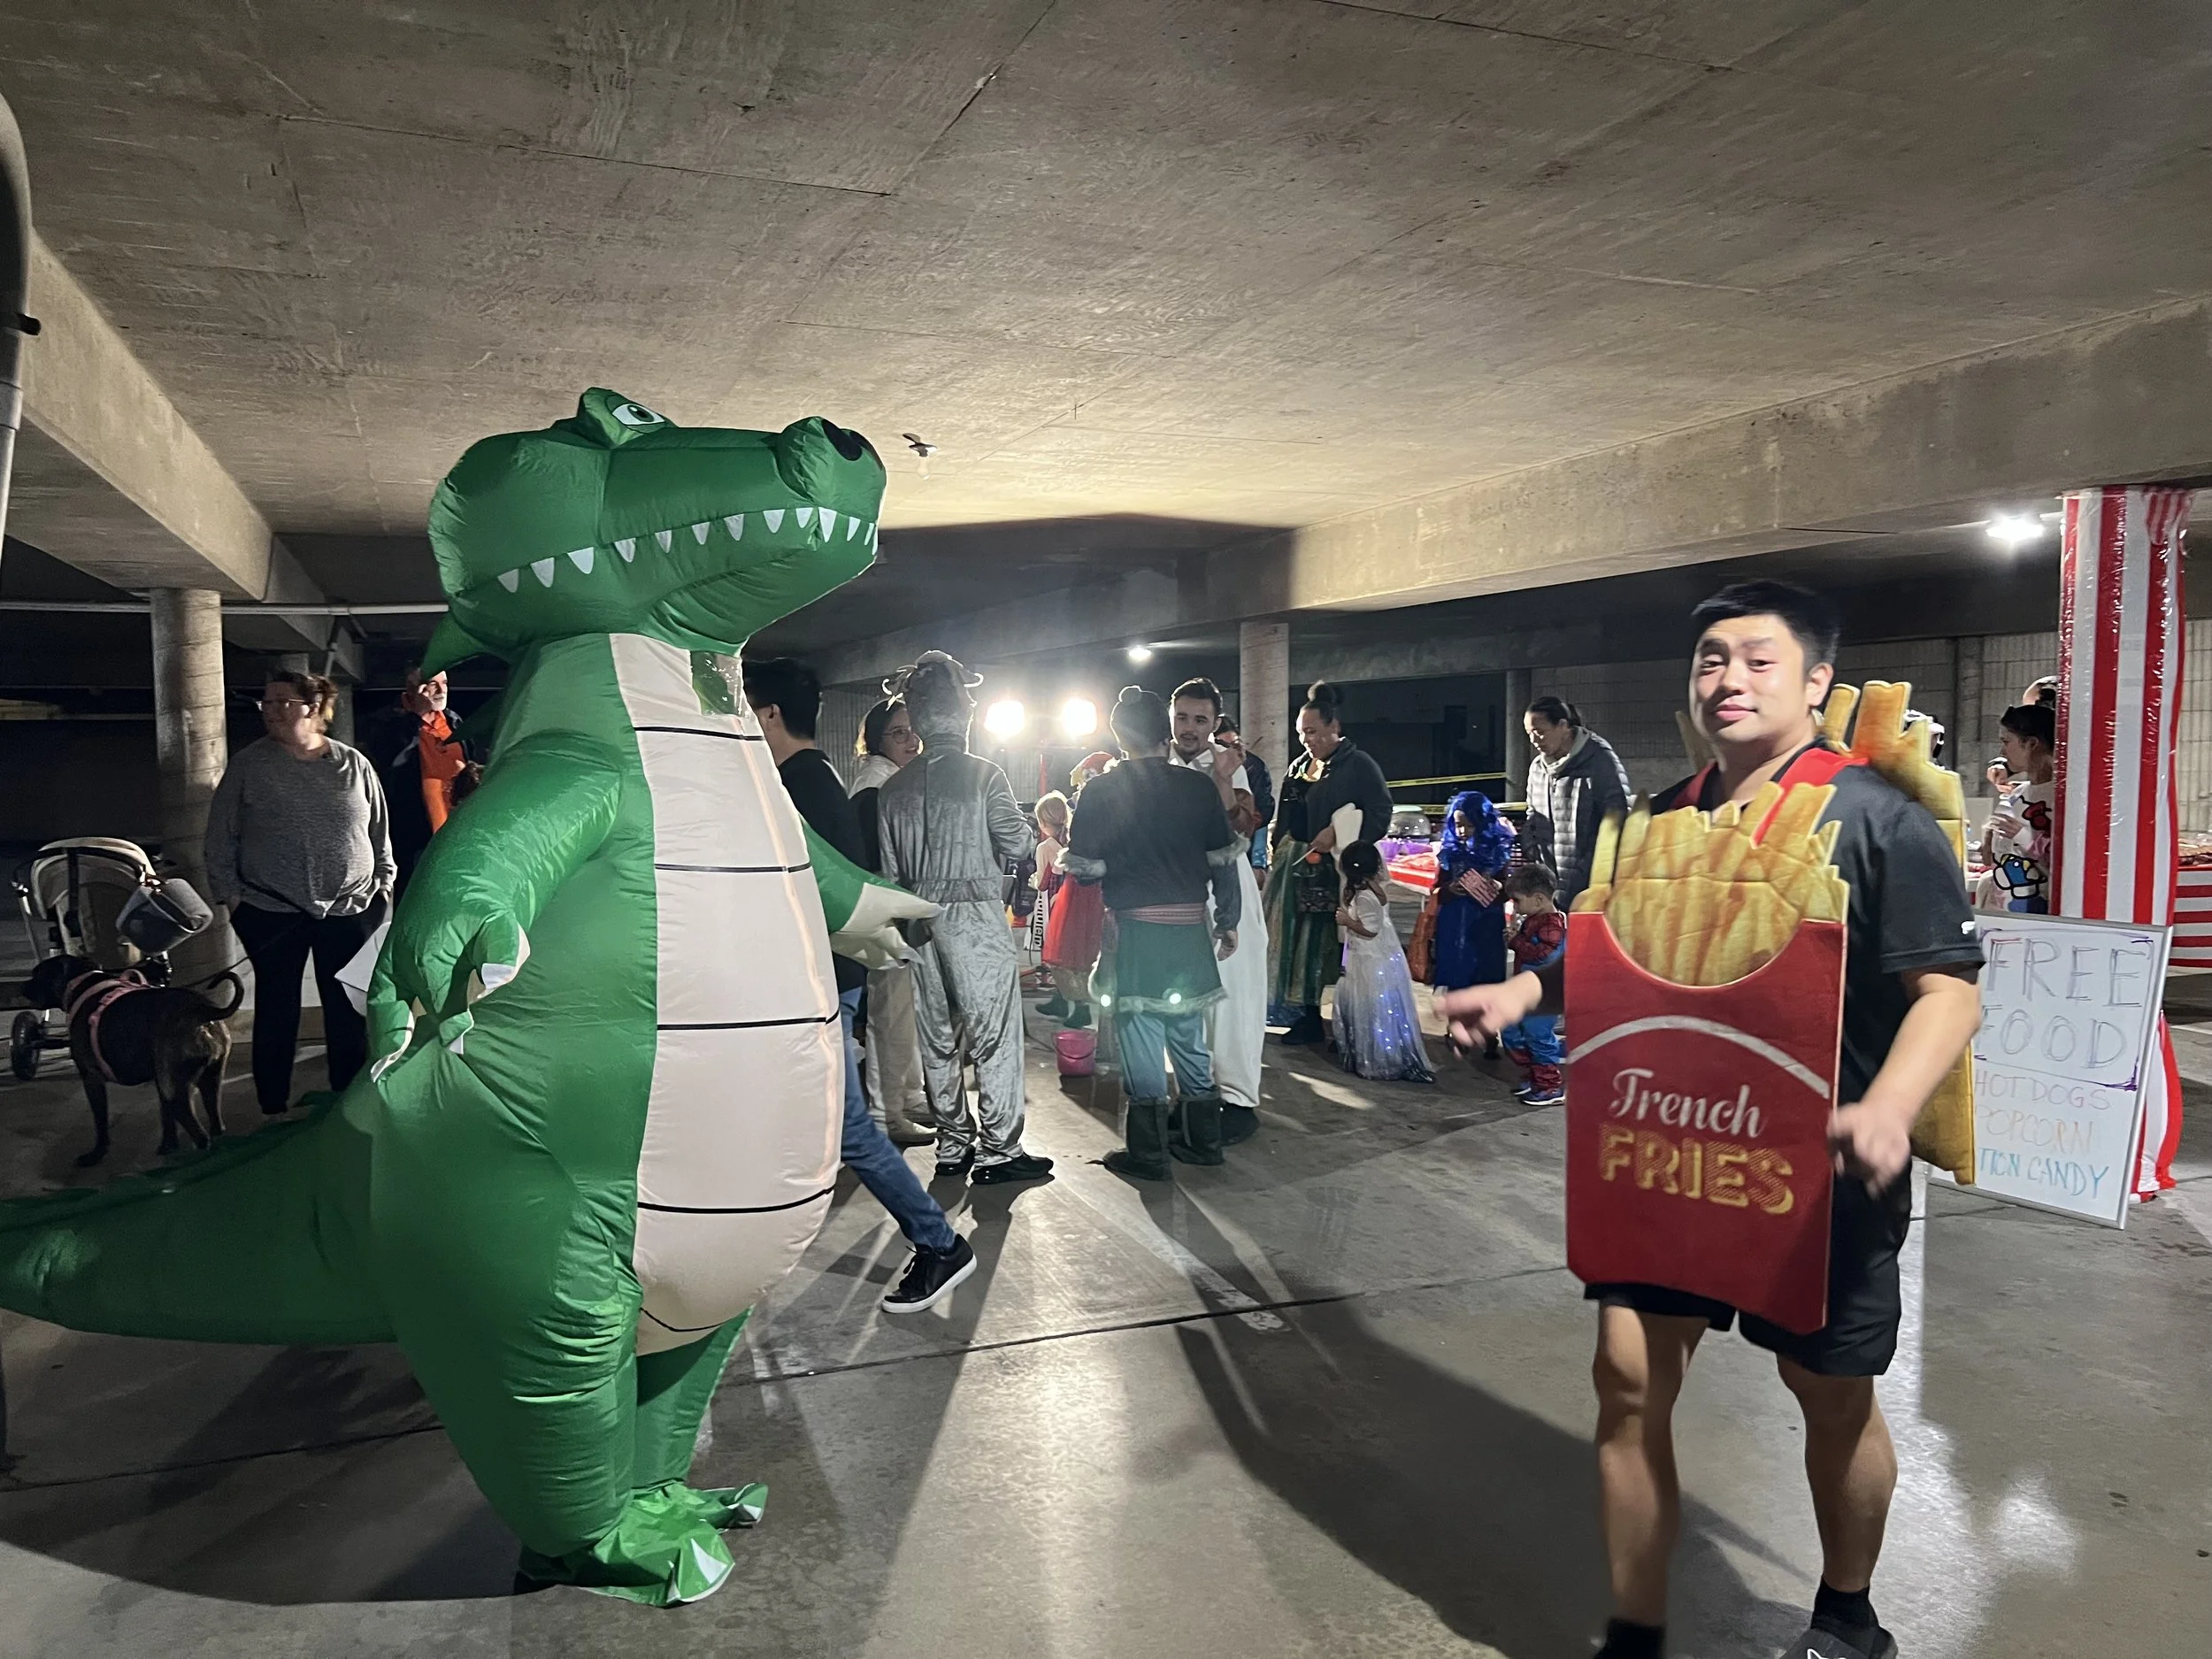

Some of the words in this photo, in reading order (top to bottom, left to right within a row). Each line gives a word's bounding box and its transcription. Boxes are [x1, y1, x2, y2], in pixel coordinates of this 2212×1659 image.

[1985, 937, 2146, 1007] FREE
[1976, 1004, 2126, 1069] FOOD
[1975, 1069, 2026, 1098] HOT
[2029, 1077, 2111, 1110] DOGS
[1599, 1122, 1794, 1214] FRIES
[2027, 1156, 2109, 1199] CANDY
